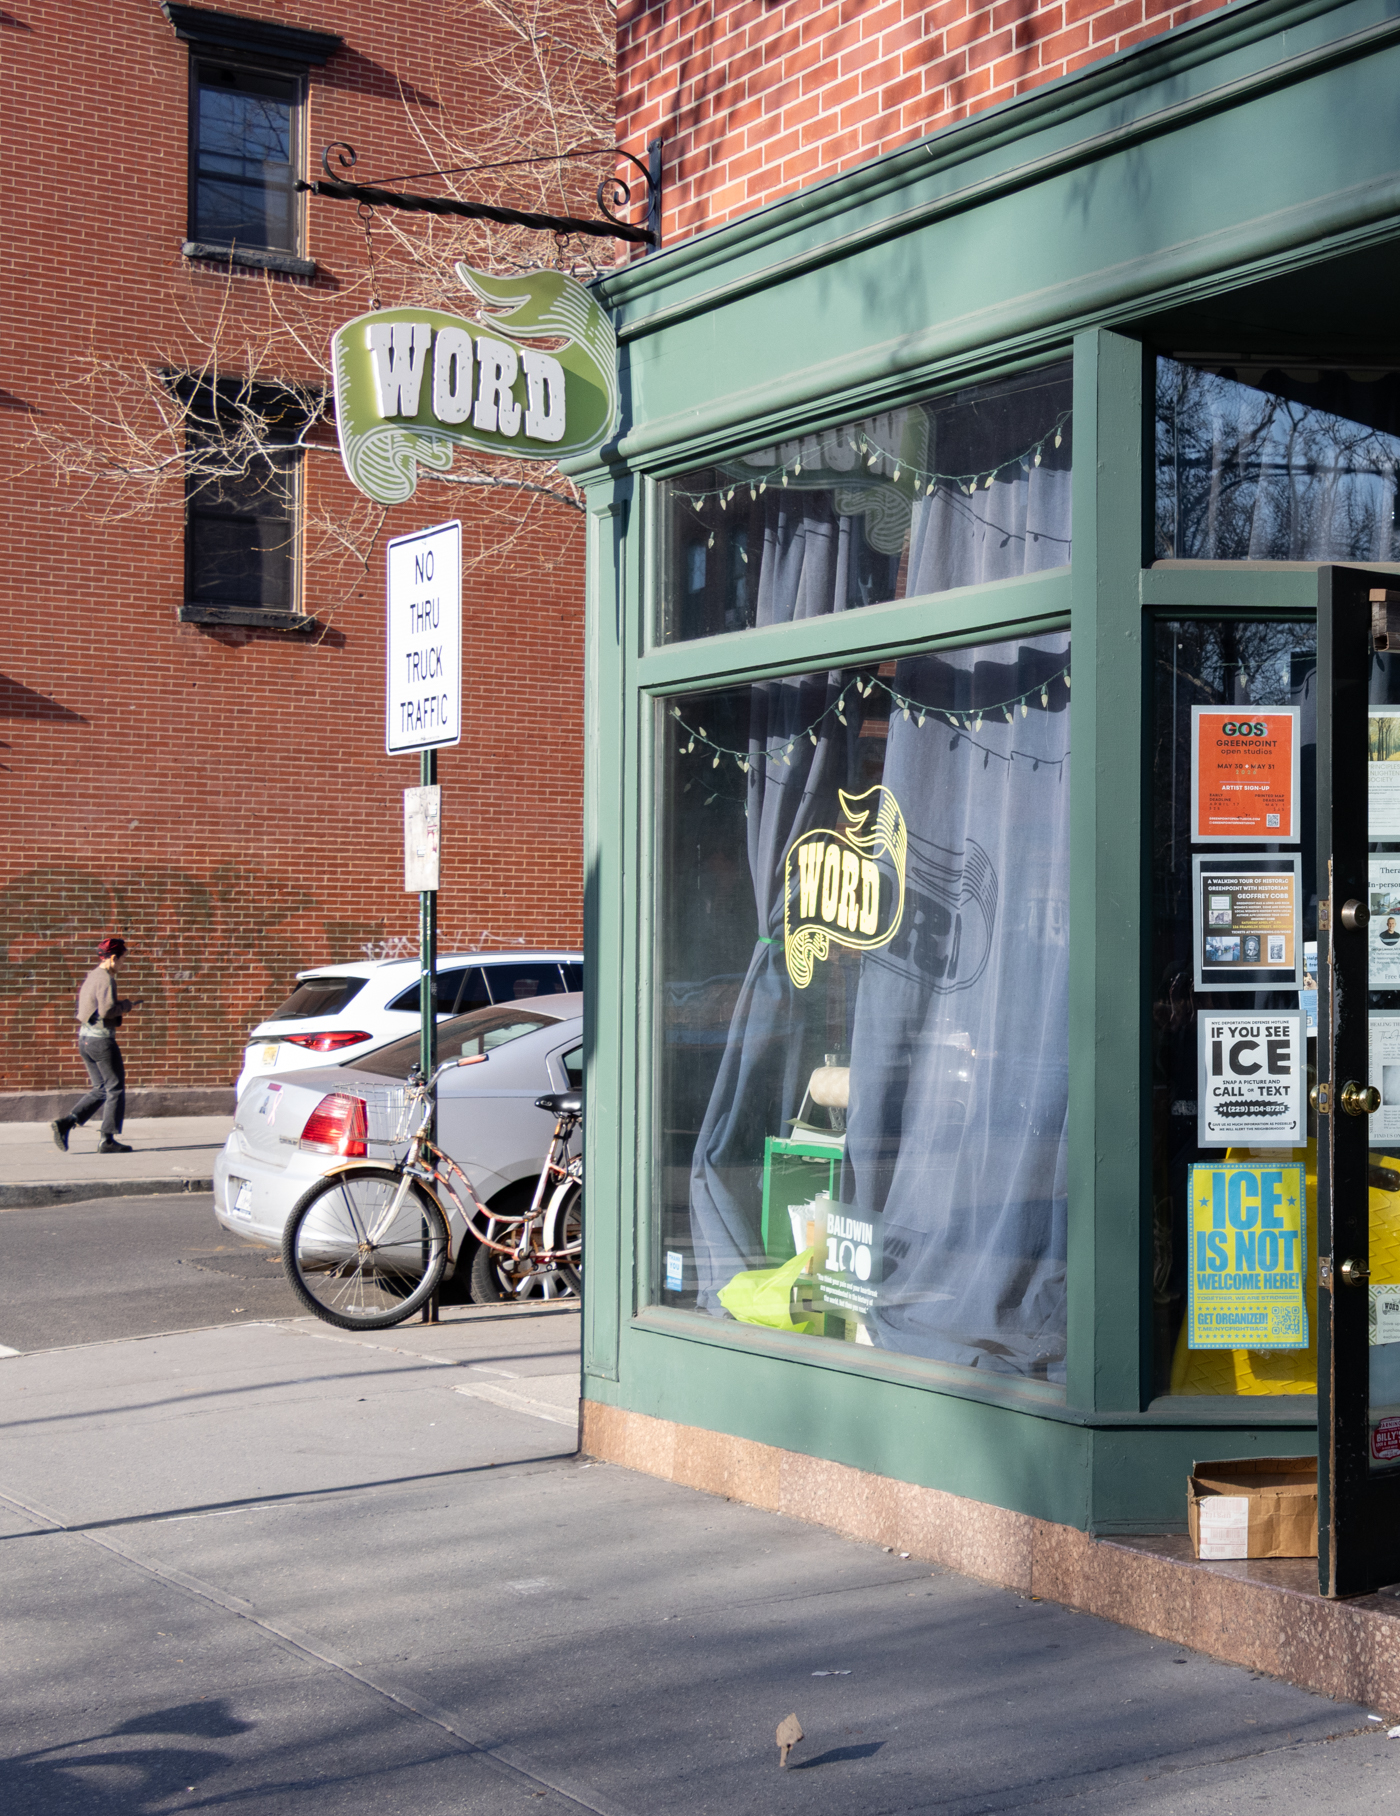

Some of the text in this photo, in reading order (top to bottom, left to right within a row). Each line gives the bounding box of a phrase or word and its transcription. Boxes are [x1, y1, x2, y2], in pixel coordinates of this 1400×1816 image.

[366, 322, 566, 443] WORD
[415, 550, 434, 585] NO
[410, 597, 440, 634] THRU
[406, 645, 443, 684] TRUCK
[400, 693, 448, 733] TRAFFIC
[1222, 722, 1267, 737] GOS
[1216, 740, 1277, 748] GREENPOINT
[799, 841, 880, 936] WORD
[1211, 1026, 1290, 1038] IF YOU SEE
[1212, 1040, 1291, 1076] ICE
[1213, 1086, 1244, 1096] CALL
[1258, 1086, 1290, 1096] TEXT
[1212, 1171, 1284, 1230] ICE
[827, 1213, 873, 1246] BALDWIN
[1197, 1230, 1298, 1272] IS NOT
[1197, 1273, 1300, 1290] WELCOME HERE!
[1198, 1313, 1268, 1325] GET ORGANIZED!
[1385, 1302, 1400, 1311] WORD
